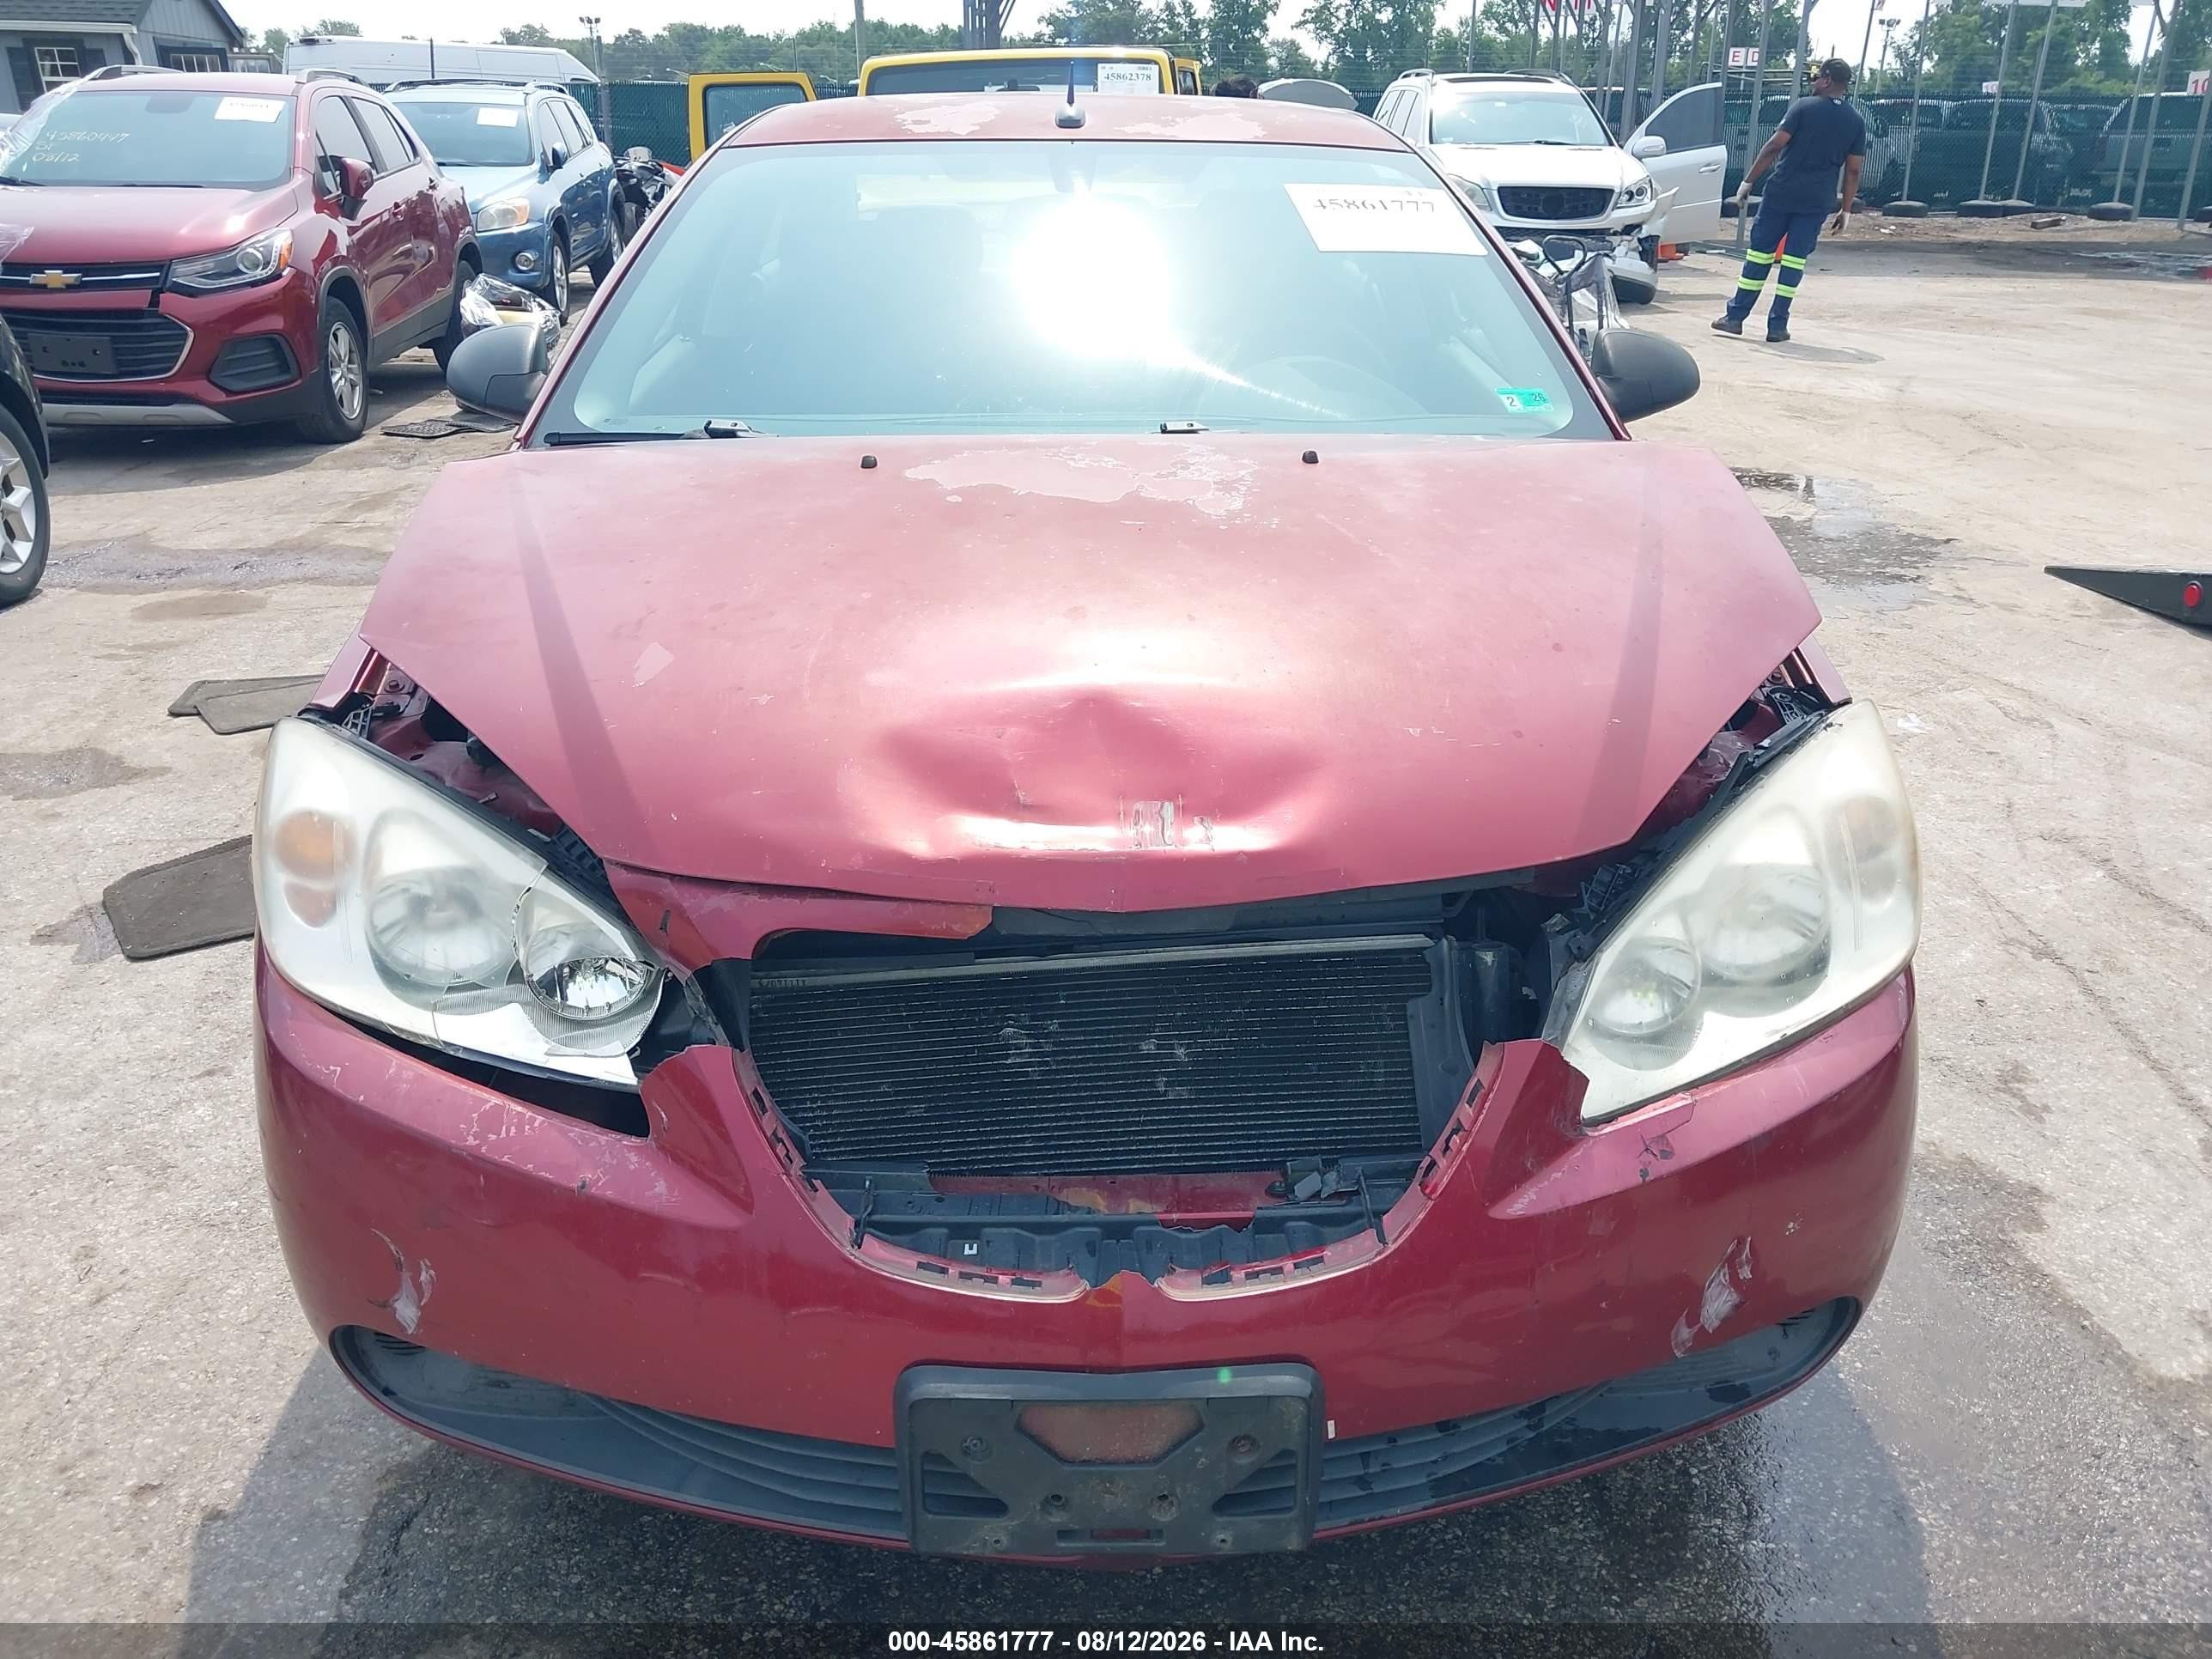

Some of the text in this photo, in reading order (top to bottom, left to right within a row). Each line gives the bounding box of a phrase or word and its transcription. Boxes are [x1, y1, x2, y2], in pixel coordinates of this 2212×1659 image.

[1731, 51, 1741, 63] E
[1103, 72, 1152, 82] 45862378
[1313, 198, 1434, 213] 45861777
[1506, 396, 1517, 407] 2
